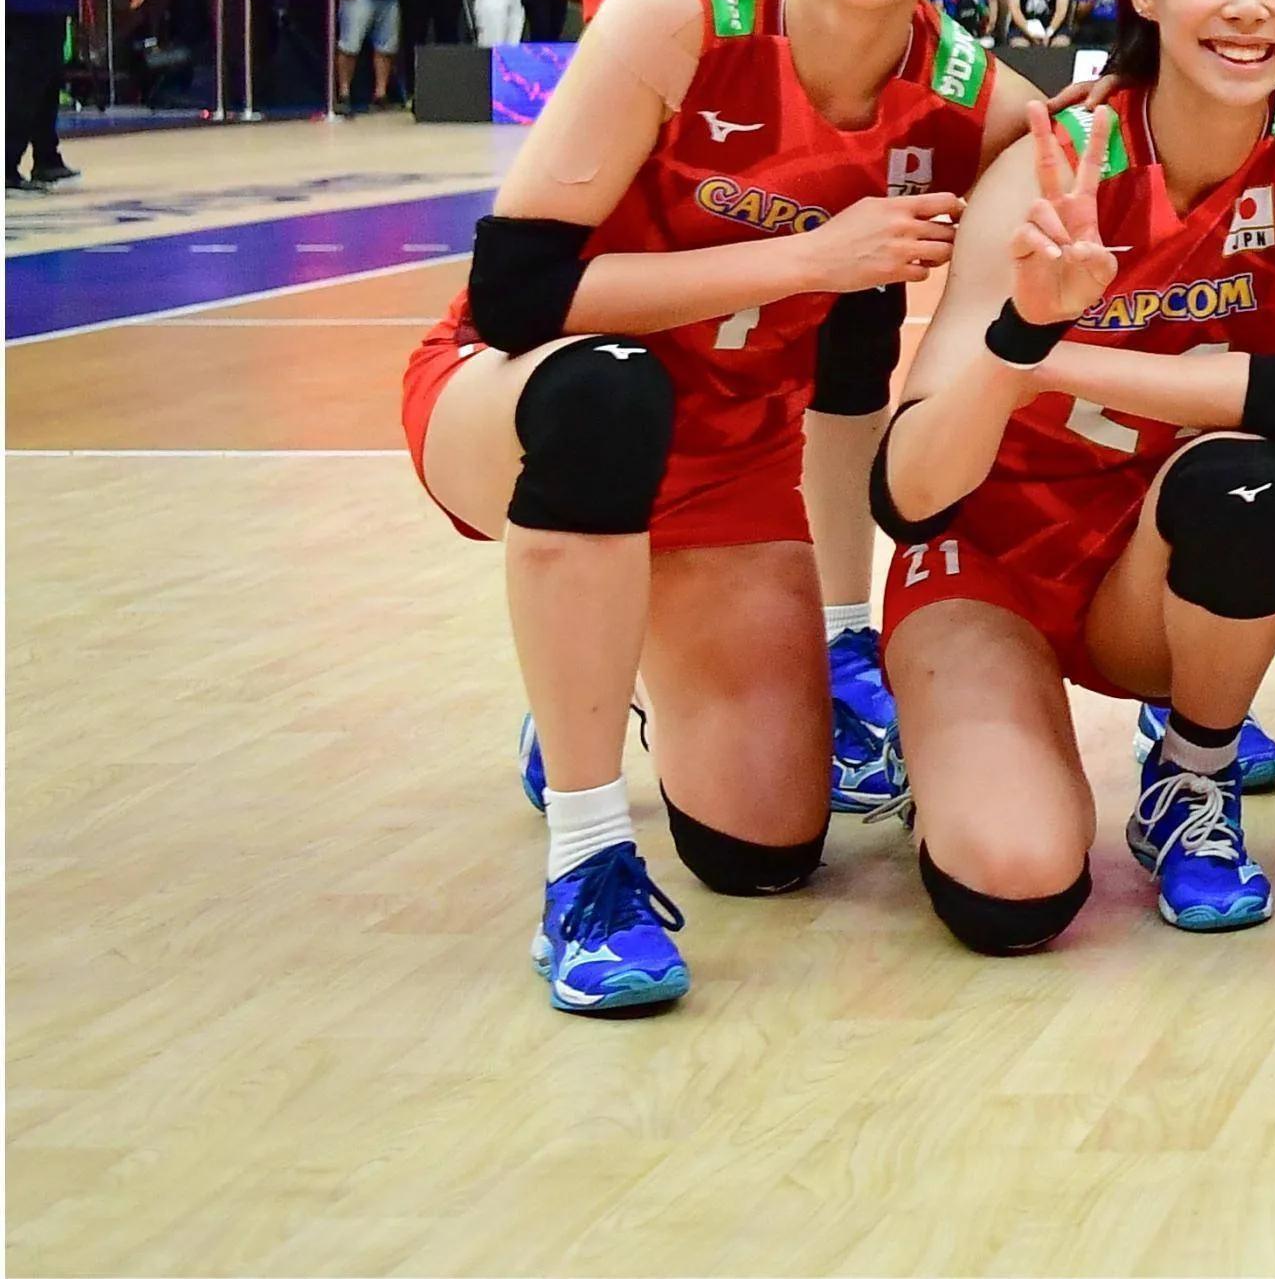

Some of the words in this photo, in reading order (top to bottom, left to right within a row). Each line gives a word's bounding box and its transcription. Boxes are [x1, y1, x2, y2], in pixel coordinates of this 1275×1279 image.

[696, 176, 832, 234] CAPC
[1232, 230, 1267, 250] JPN
[902, 539, 960, 588] 21
